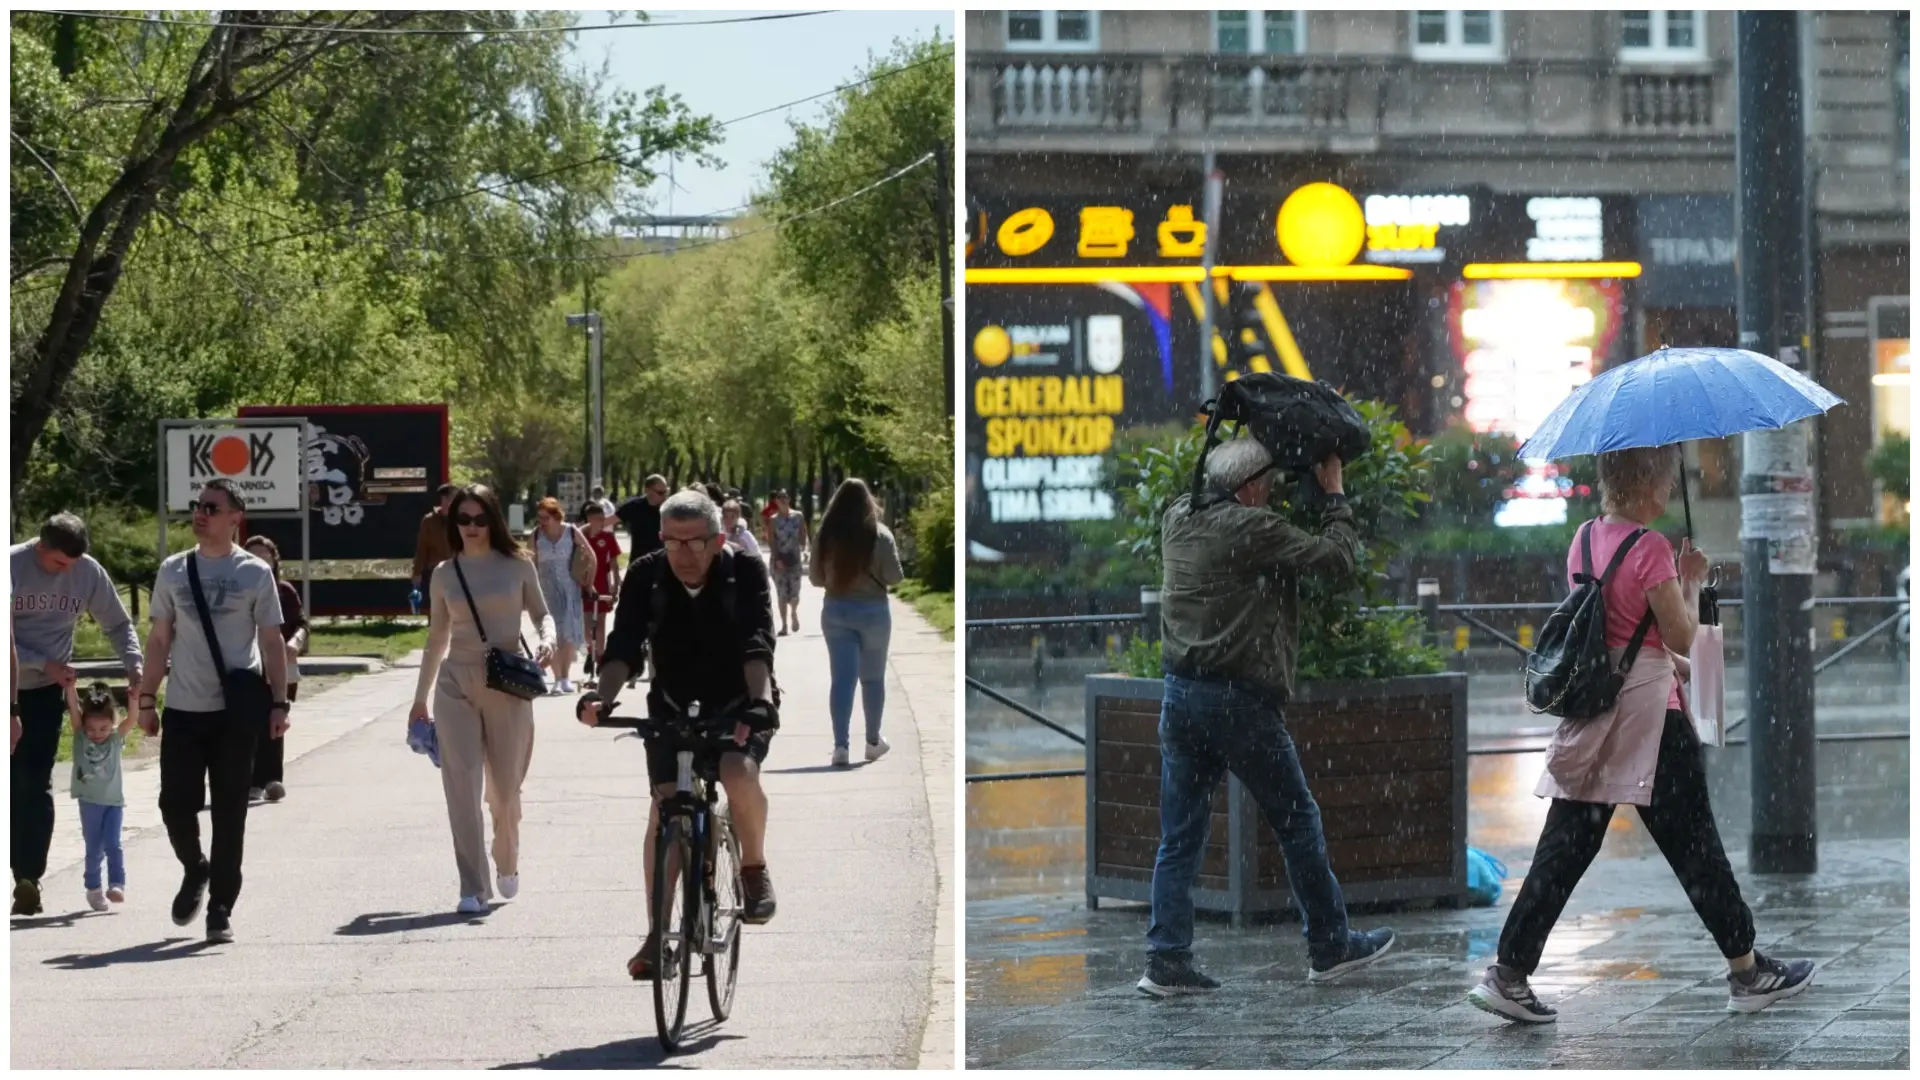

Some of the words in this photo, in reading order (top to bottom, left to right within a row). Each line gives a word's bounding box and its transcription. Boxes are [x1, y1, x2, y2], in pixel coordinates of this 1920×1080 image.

[975, 375, 1124, 416] GENERALNI
[986, 415, 1115, 457] SPONZOR
[15, 594, 81, 613] BOSTON
